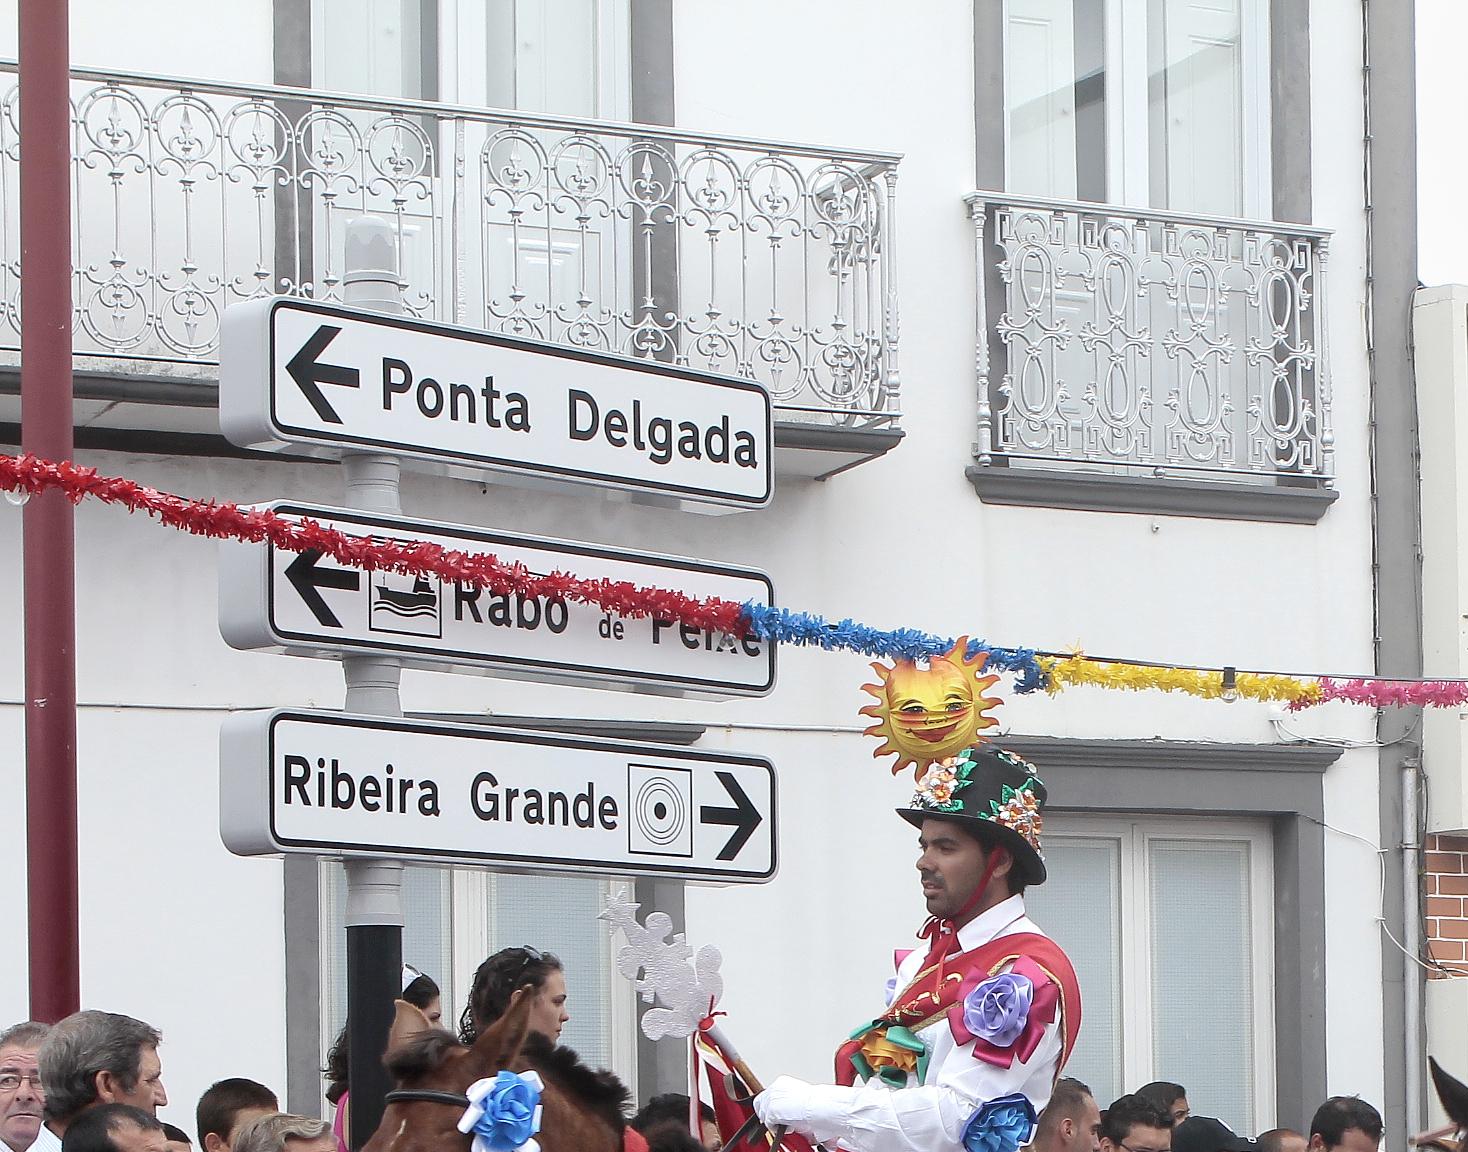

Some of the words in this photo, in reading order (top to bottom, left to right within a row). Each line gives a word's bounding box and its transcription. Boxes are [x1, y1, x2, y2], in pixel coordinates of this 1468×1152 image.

[382, 357, 531, 433] Ponta
[568, 388, 758, 469] Delgada
[454, 575, 569, 634] Rabo
[598, 610, 625, 640] de
[284, 755, 441, 817] Ribeira
[470, 771, 618, 830] Grande
